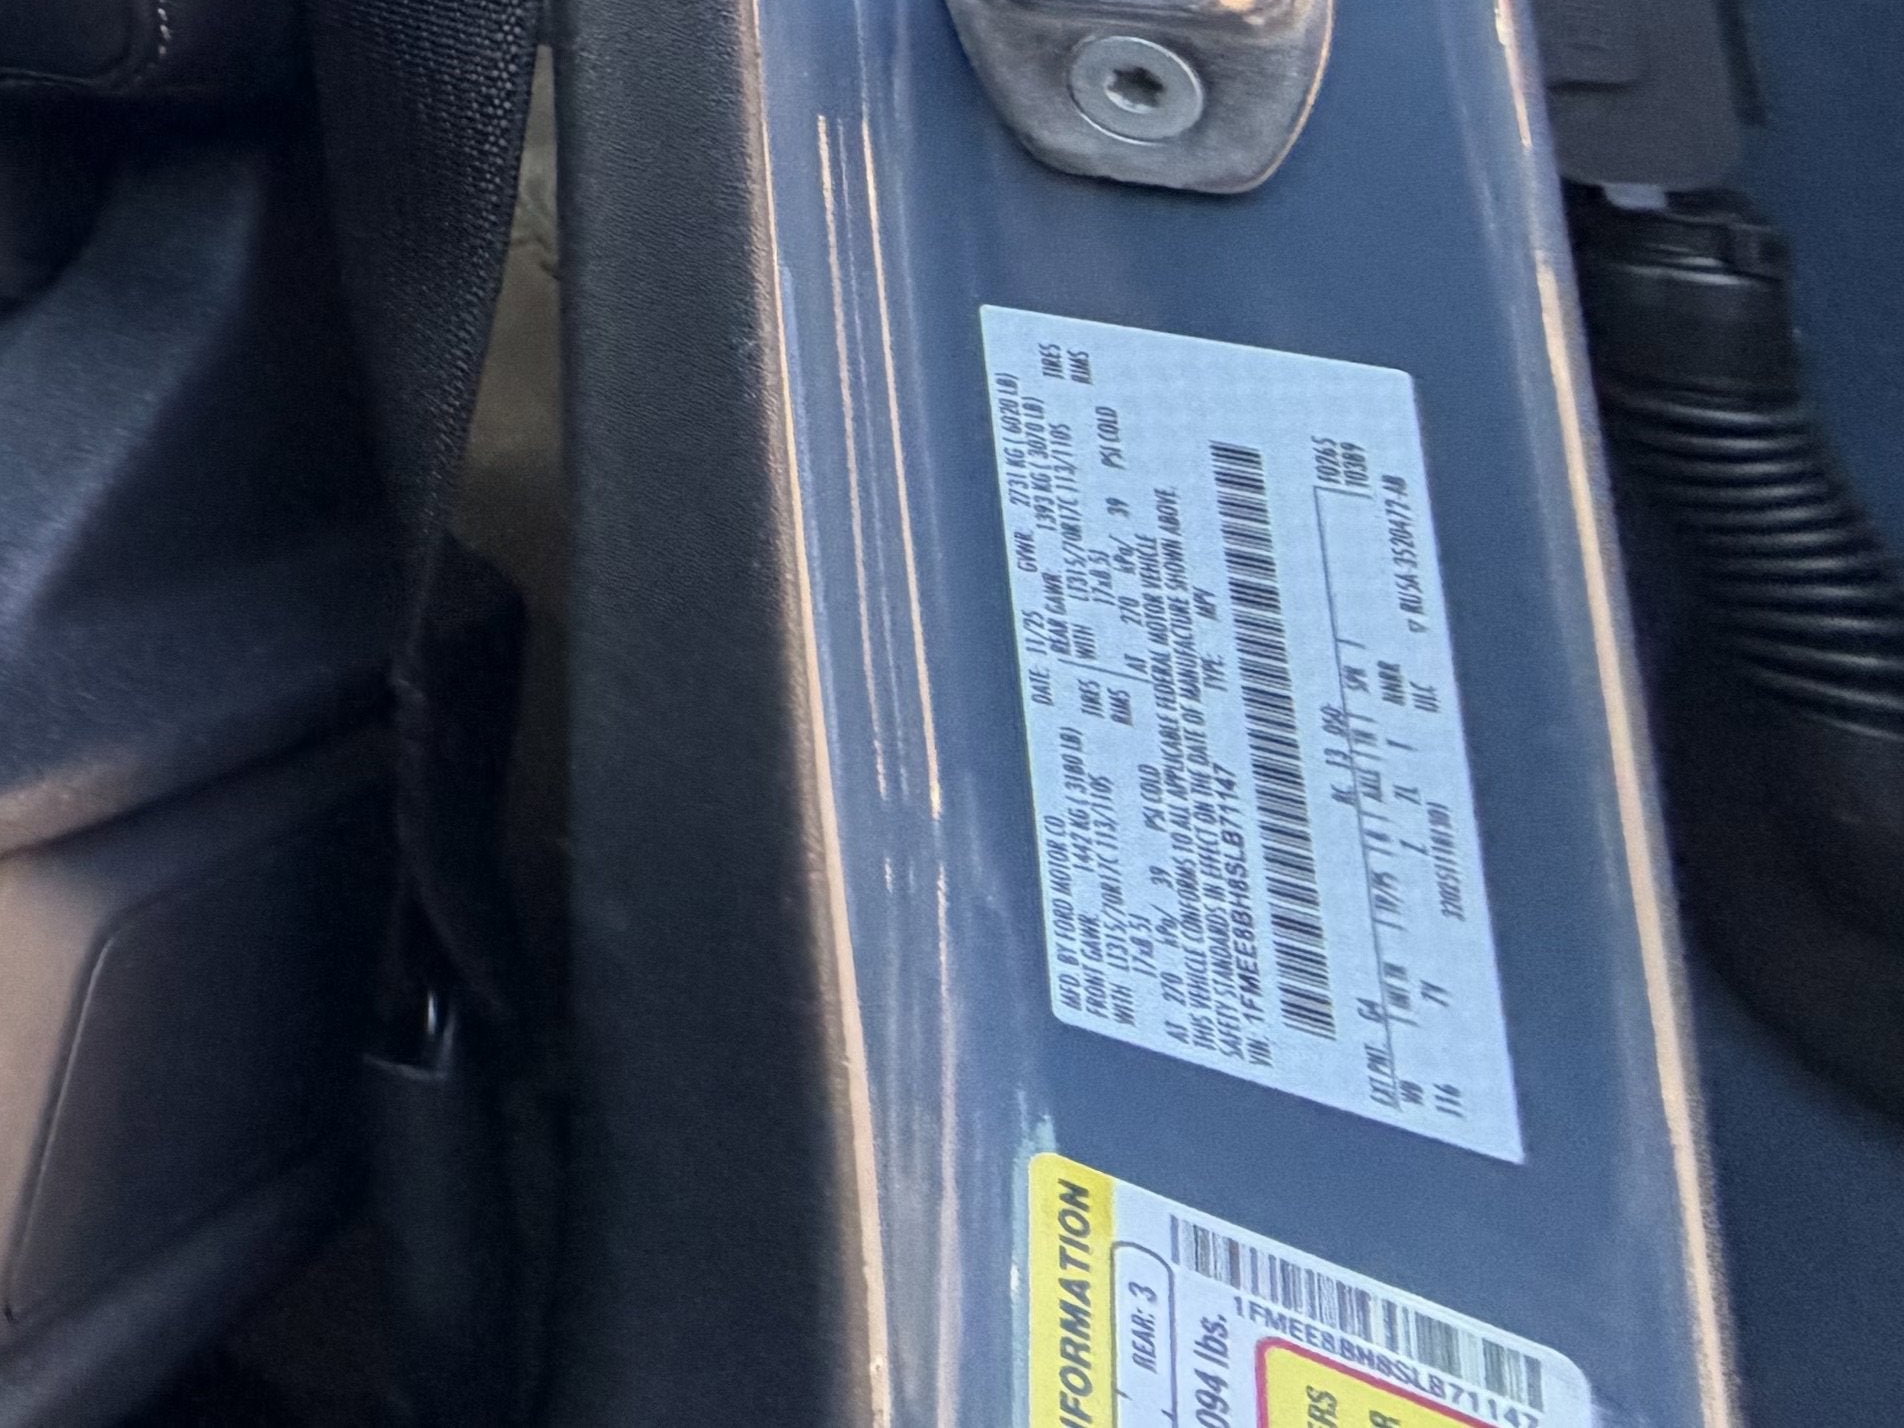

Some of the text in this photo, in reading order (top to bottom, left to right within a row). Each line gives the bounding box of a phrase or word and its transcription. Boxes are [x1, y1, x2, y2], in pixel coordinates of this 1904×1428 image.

[1041, 343, 1063, 378] TIRES
[1068, 350, 1091, 384] RIMS
[996, 372, 1018, 394] LB)
[1000, 398, 1021, 433] 6020
[1023, 396, 1043, 418] LB)
[1096, 406, 1119, 441] COLD
[1005, 447, 1025, 467] KG
[1026, 422, 1048, 458] 3070
[1101, 445, 1124, 469] PSI
[1008, 472, 1030, 506] 2731
[1031, 473, 1051, 491] KG
[1035, 495, 1055, 530] 1393
[1106, 497, 1129, 516] 39
[1163, 538, 1187, 590] SHOWN
[1119, 596, 1141, 625] 270
[1194, 586, 1217, 619] MPV
[1023, 609, 1047, 654] 11/25
[1048, 618, 1069, 654] REAR
[1074, 624, 1095, 658] WITH
[1169, 596, 1200, 701] MANUFACTURE
[1125, 653, 1146, 673] AT
[1079, 678, 1103, 717] TIRES
[1108, 687, 1131, 725] RIMS
[1182, 705, 1204, 724] OF
[1060, 726, 1082, 751] LB)
[1185, 728, 1209, 765] DATE
[1063, 753, 1085, 792] 3180
[1139, 763, 1161, 802] COLD
[1189, 769, 1211, 795] THE
[1136, 533, 1215, 1049] THIS VEHICLE CONFORMS TO ALL APPLICABLE FEDERAL MOTOR VEHICLE
[1069, 808, 1089, 829] KG
[1143, 806, 1165, 831] PSI
[1194, 801, 1216, 823] ON
[1048, 839, 1071, 895] MOTOR
[1071, 832, 1093, 871] 1442
[1196, 827, 1222, 878] EFFECT
[1150, 865, 1172, 887] 39
[1205, 883, 1224, 900] IN
[1054, 898, 1074, 940] FORD
[1057, 942, 1078, 965] BY
[1206, 906, 1236, 996] STANDARDS
[1084, 964, 1107, 1017] FRONT
[1112, 983, 1134, 1025] WITH
[1162, 971, 1185, 1005] 270
[1165, 1020, 1188, 1043] AT
[1217, 1000, 1243, 1058] SAFETY
[1370, 1076, 1394, 1107] EXT
[1128, 1282, 1157, 1374] REAR: 3
[1194, 1314, 1230, 1369] lbs.
